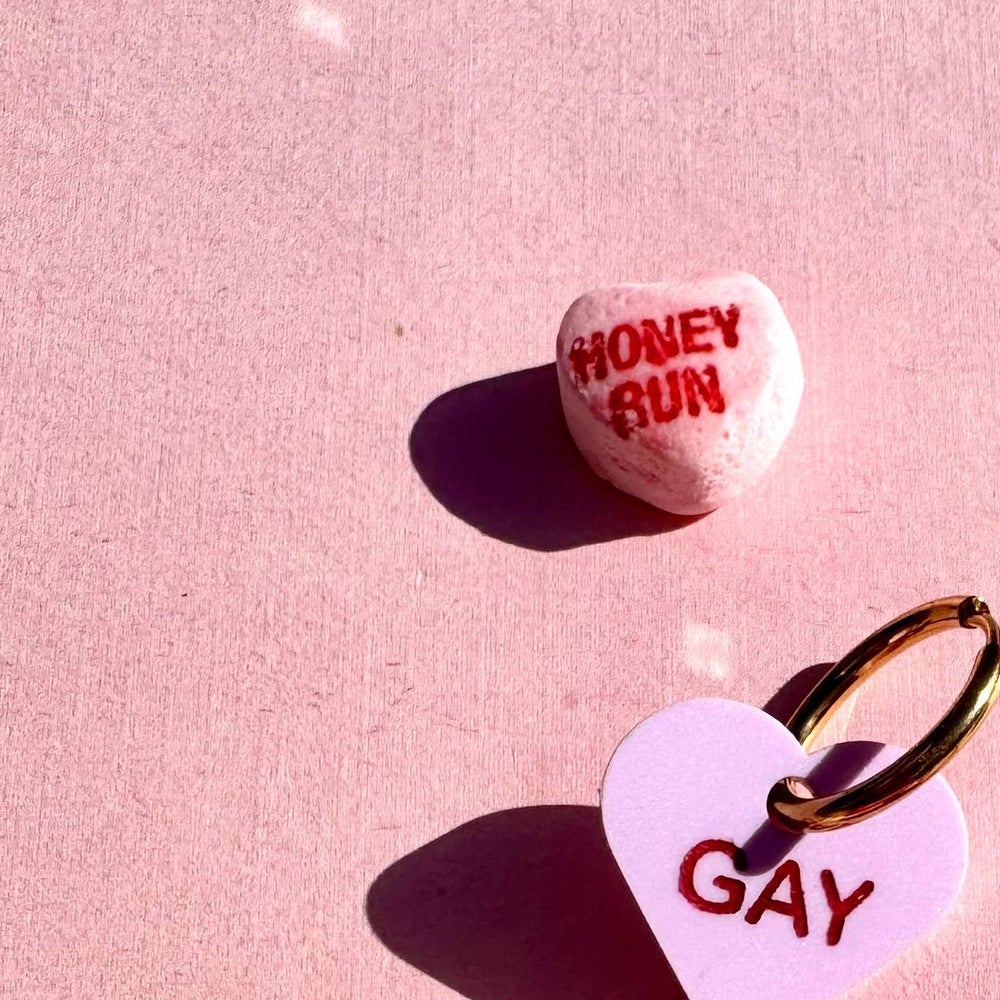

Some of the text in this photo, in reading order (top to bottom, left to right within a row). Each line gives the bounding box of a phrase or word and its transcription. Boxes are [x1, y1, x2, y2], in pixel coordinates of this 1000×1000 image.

[569, 303, 740, 385] HONEY
[608, 364, 726, 440] BUN
[678, 838, 875, 946] GAY
